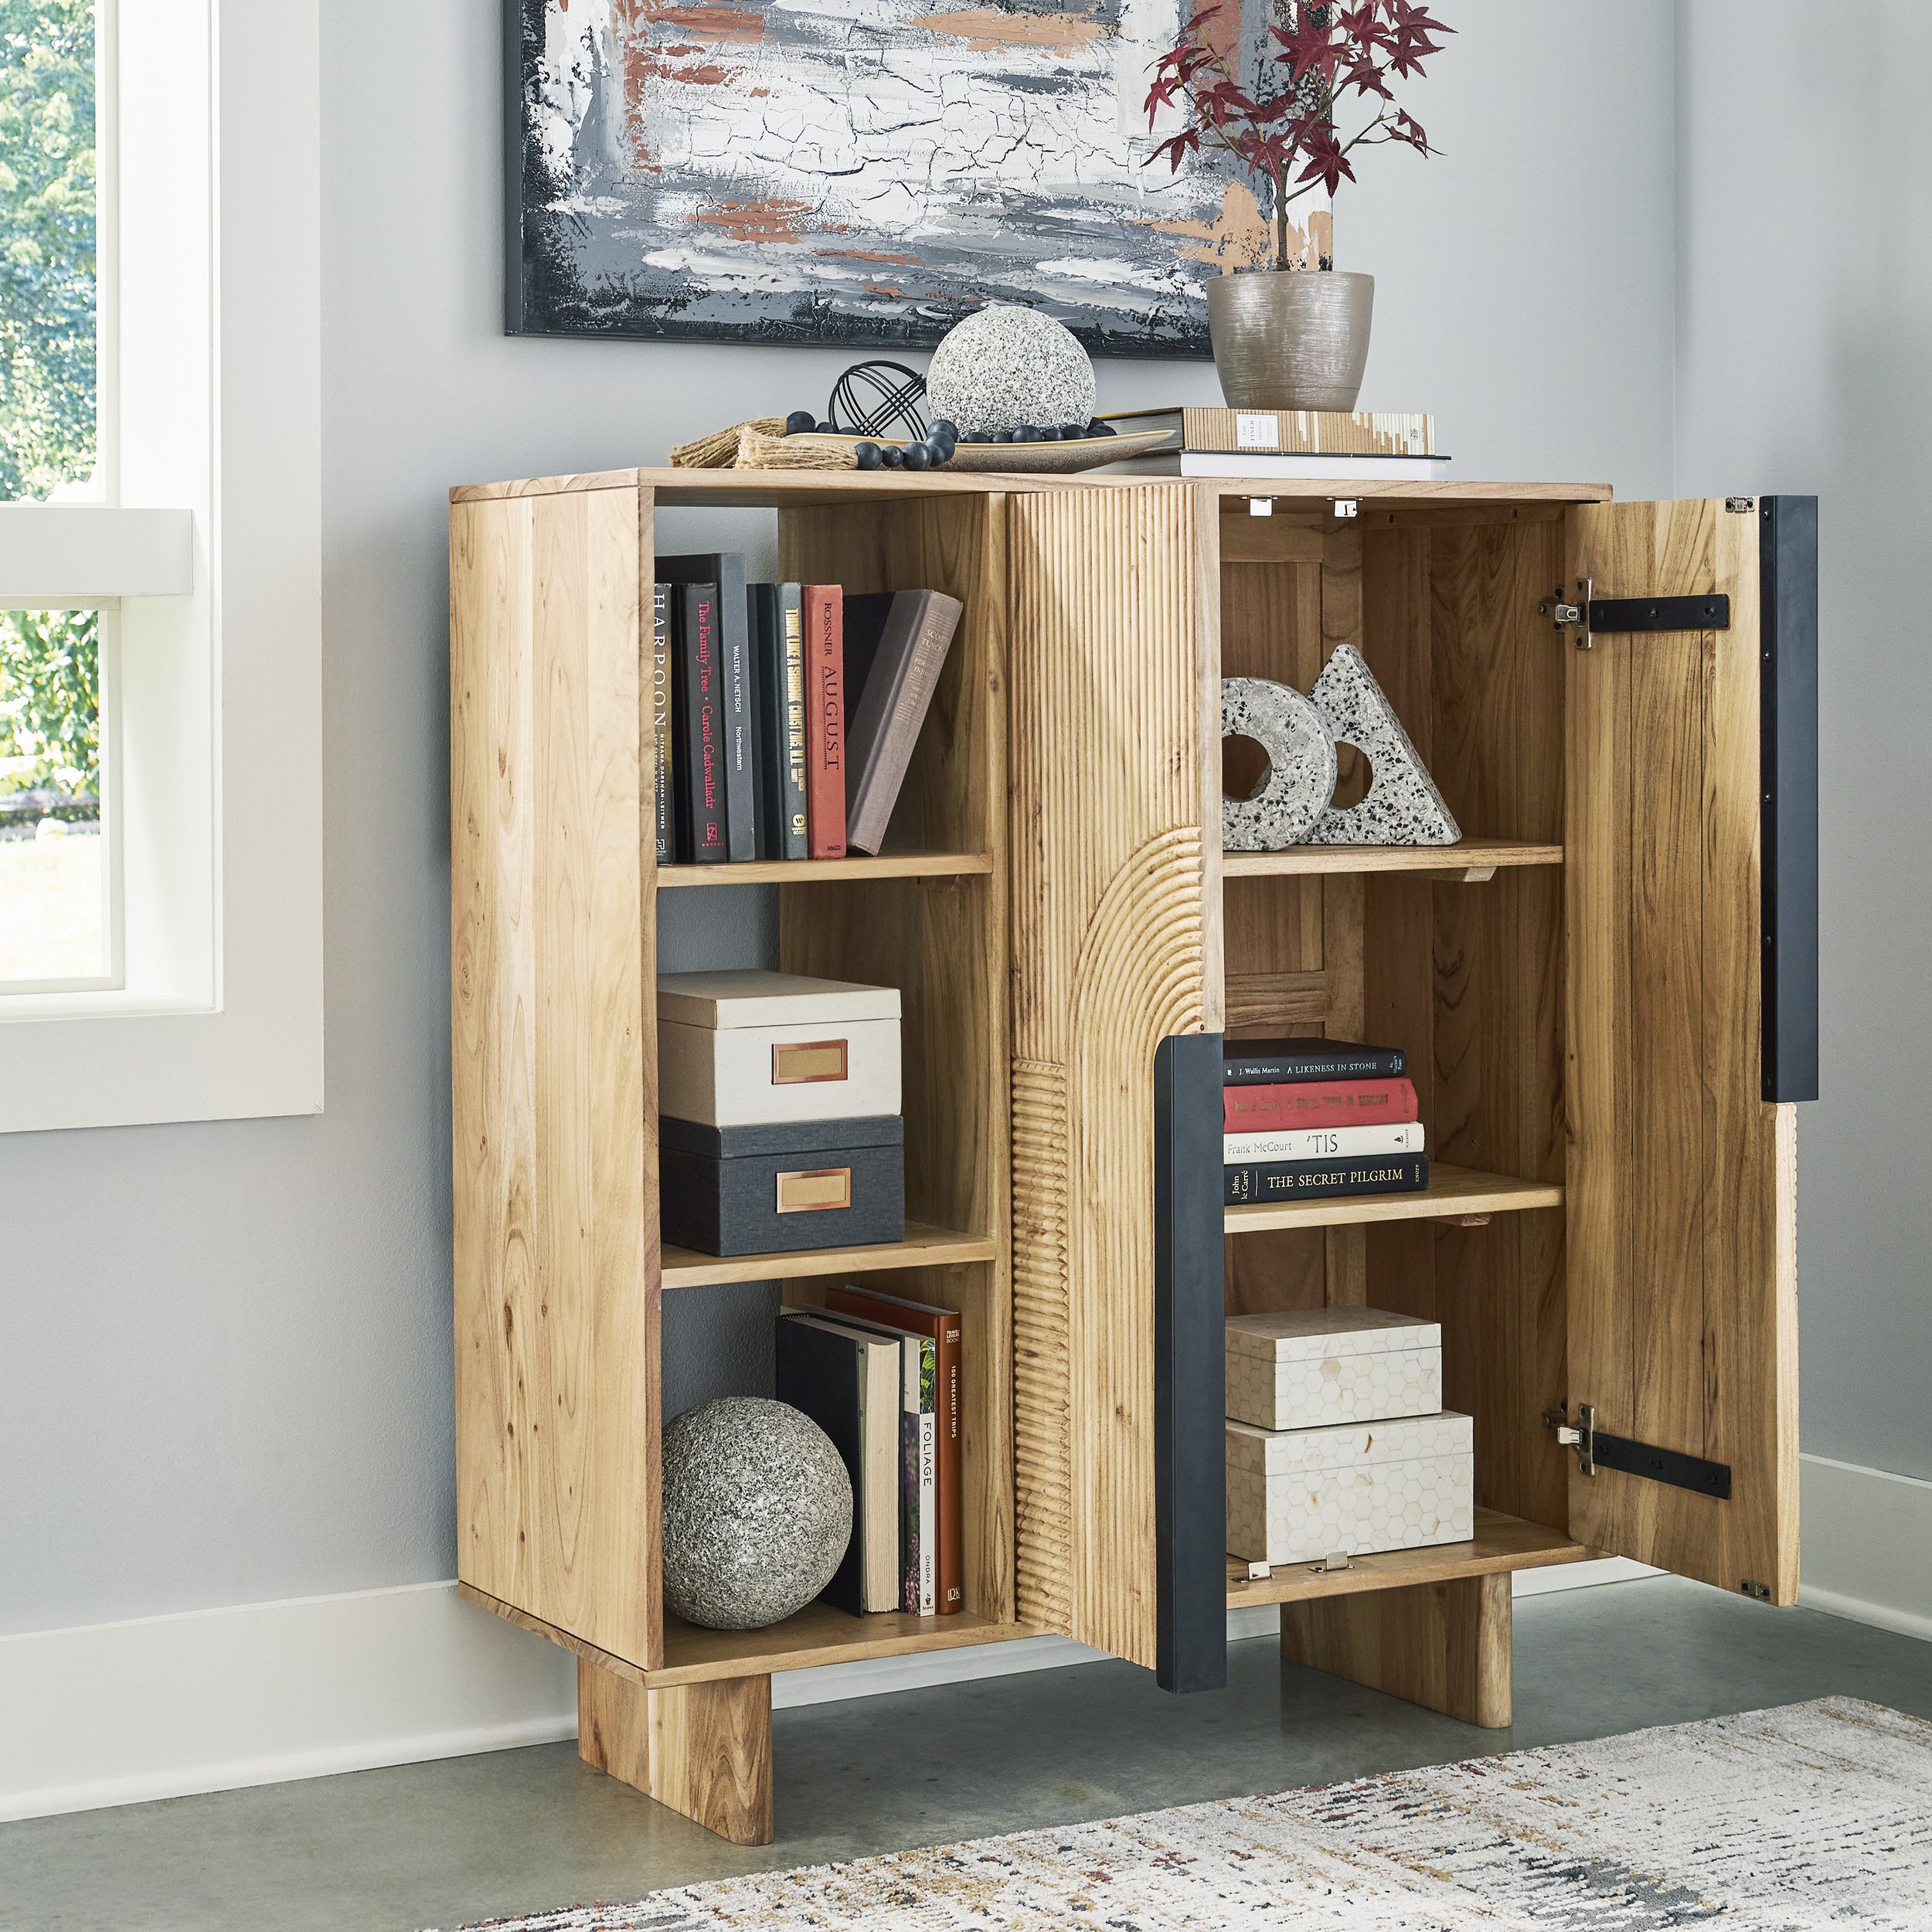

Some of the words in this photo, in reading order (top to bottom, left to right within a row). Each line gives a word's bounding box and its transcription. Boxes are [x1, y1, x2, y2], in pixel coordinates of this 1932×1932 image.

[699, 601, 710, 623] The
[785, 607, 800, 638] THINK
[824, 602, 833, 657] ROSSNER
[696, 625, 711, 665] Family
[786, 638, 801, 658] LIKE
[655, 593, 665, 726] HARPOON
[733, 645, 741, 674] WALTER
[787, 658, 801, 666] A
[700, 665, 711, 692] Tree
[734, 675, 740, 683] A.
[787, 665, 802, 702] SHRINK
[702, 706, 713, 743] Carole
[825, 665, 839, 770] AUGUST
[702, 744, 716, 809] Cadwalladr
[1239, 1068, 1244, 1077] J.
[1287, 1066, 1293, 1074] A
[1295, 1064, 1335, 1073] LIKENESS
[1337, 1063, 1347, 1072] IN
[1349, 1062, 1377, 1070] STONE
[1227, 1142, 1250, 1155] Frank
[1253, 1141, 1292, 1152] McCourt
[1306, 1134, 1338, 1154] 'TIS
[1240, 1169, 1249, 1192] Carré
[1267, 1175, 1294, 1189] THE
[1298, 1172, 1346, 1188] SECRET
[1349, 1168, 1403, 1183] PILGRIM
[923, 1422, 932, 1487] FOLIAGE
